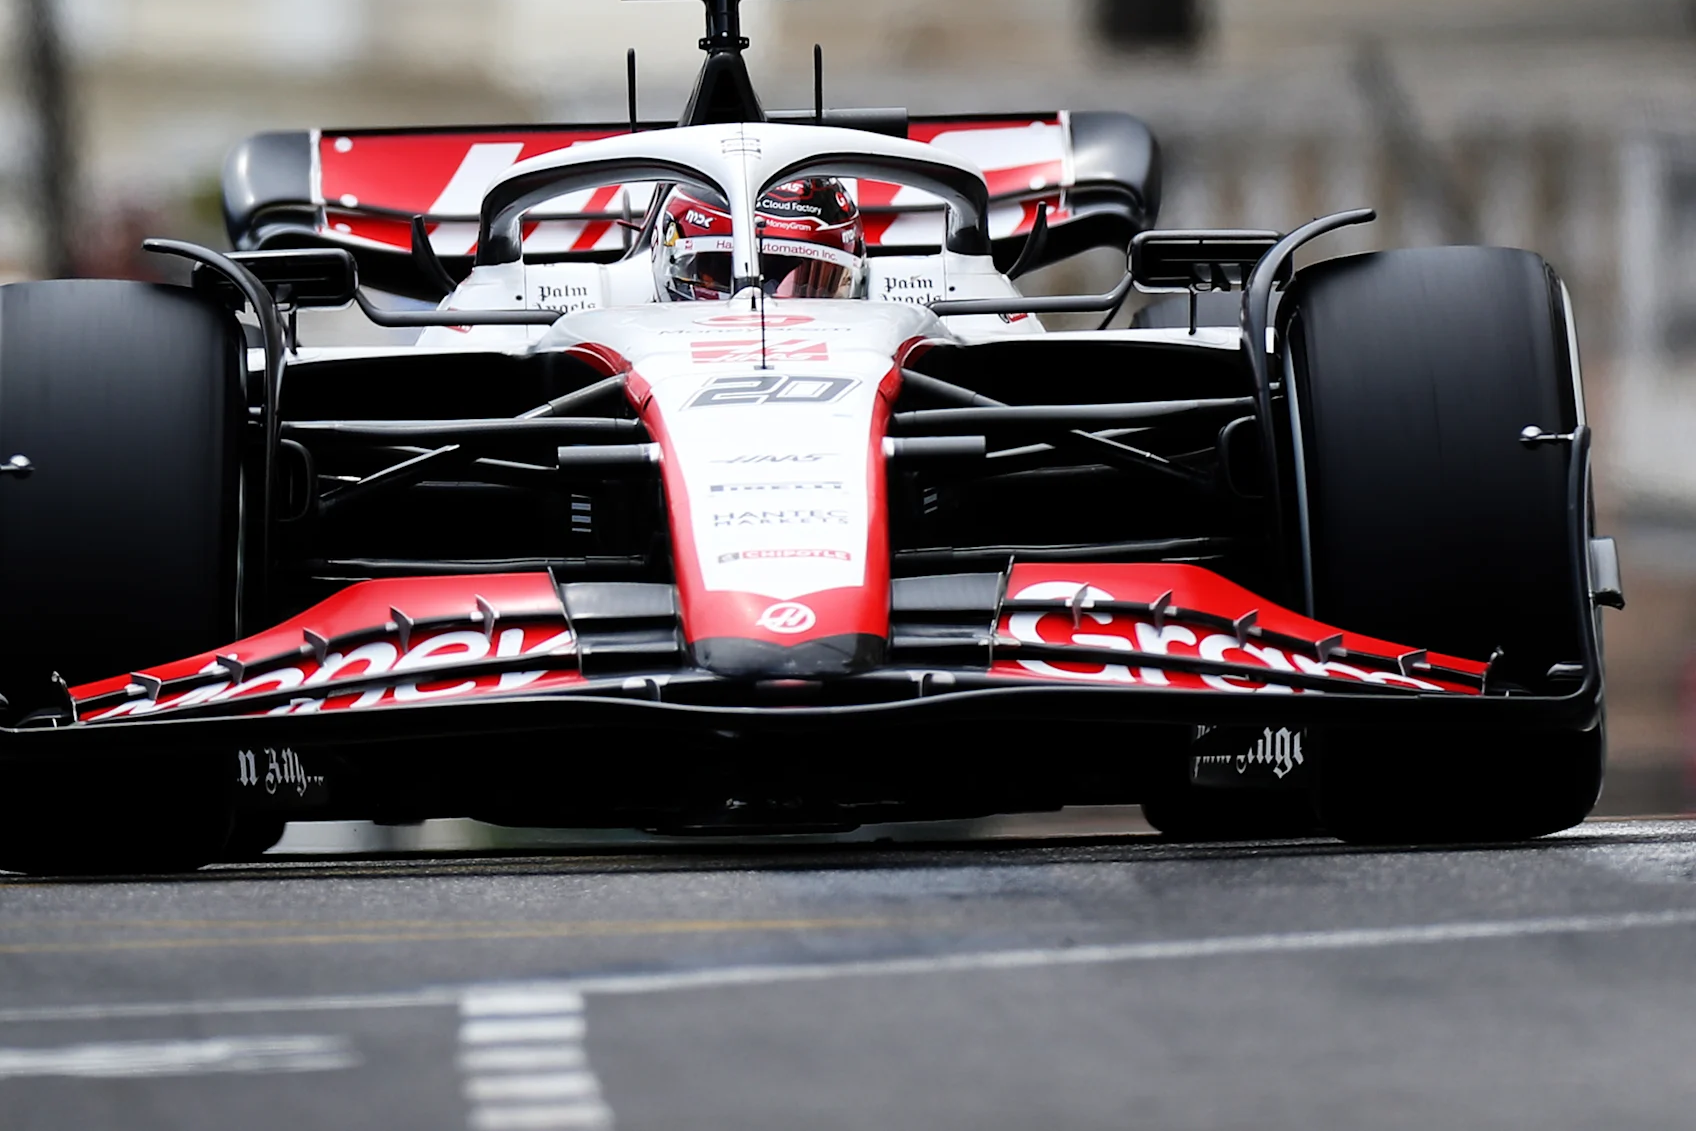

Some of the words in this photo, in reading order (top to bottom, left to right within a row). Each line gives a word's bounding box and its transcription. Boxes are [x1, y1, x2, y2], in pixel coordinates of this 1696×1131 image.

[762, 200, 790, 211] Cloud
[791, 203, 822, 216] Factory
[766, 220, 812, 232] MoneyGram
[760, 242, 819, 258] utomation
[822, 249, 838, 262] Inc.
[884, 276, 933, 293] Palm
[538, 285, 588, 302] Palm
[682, 374, 860, 409] 20
[713, 510, 850, 521] HANTEC
[743, 549, 852, 561] CHIPOTLE
